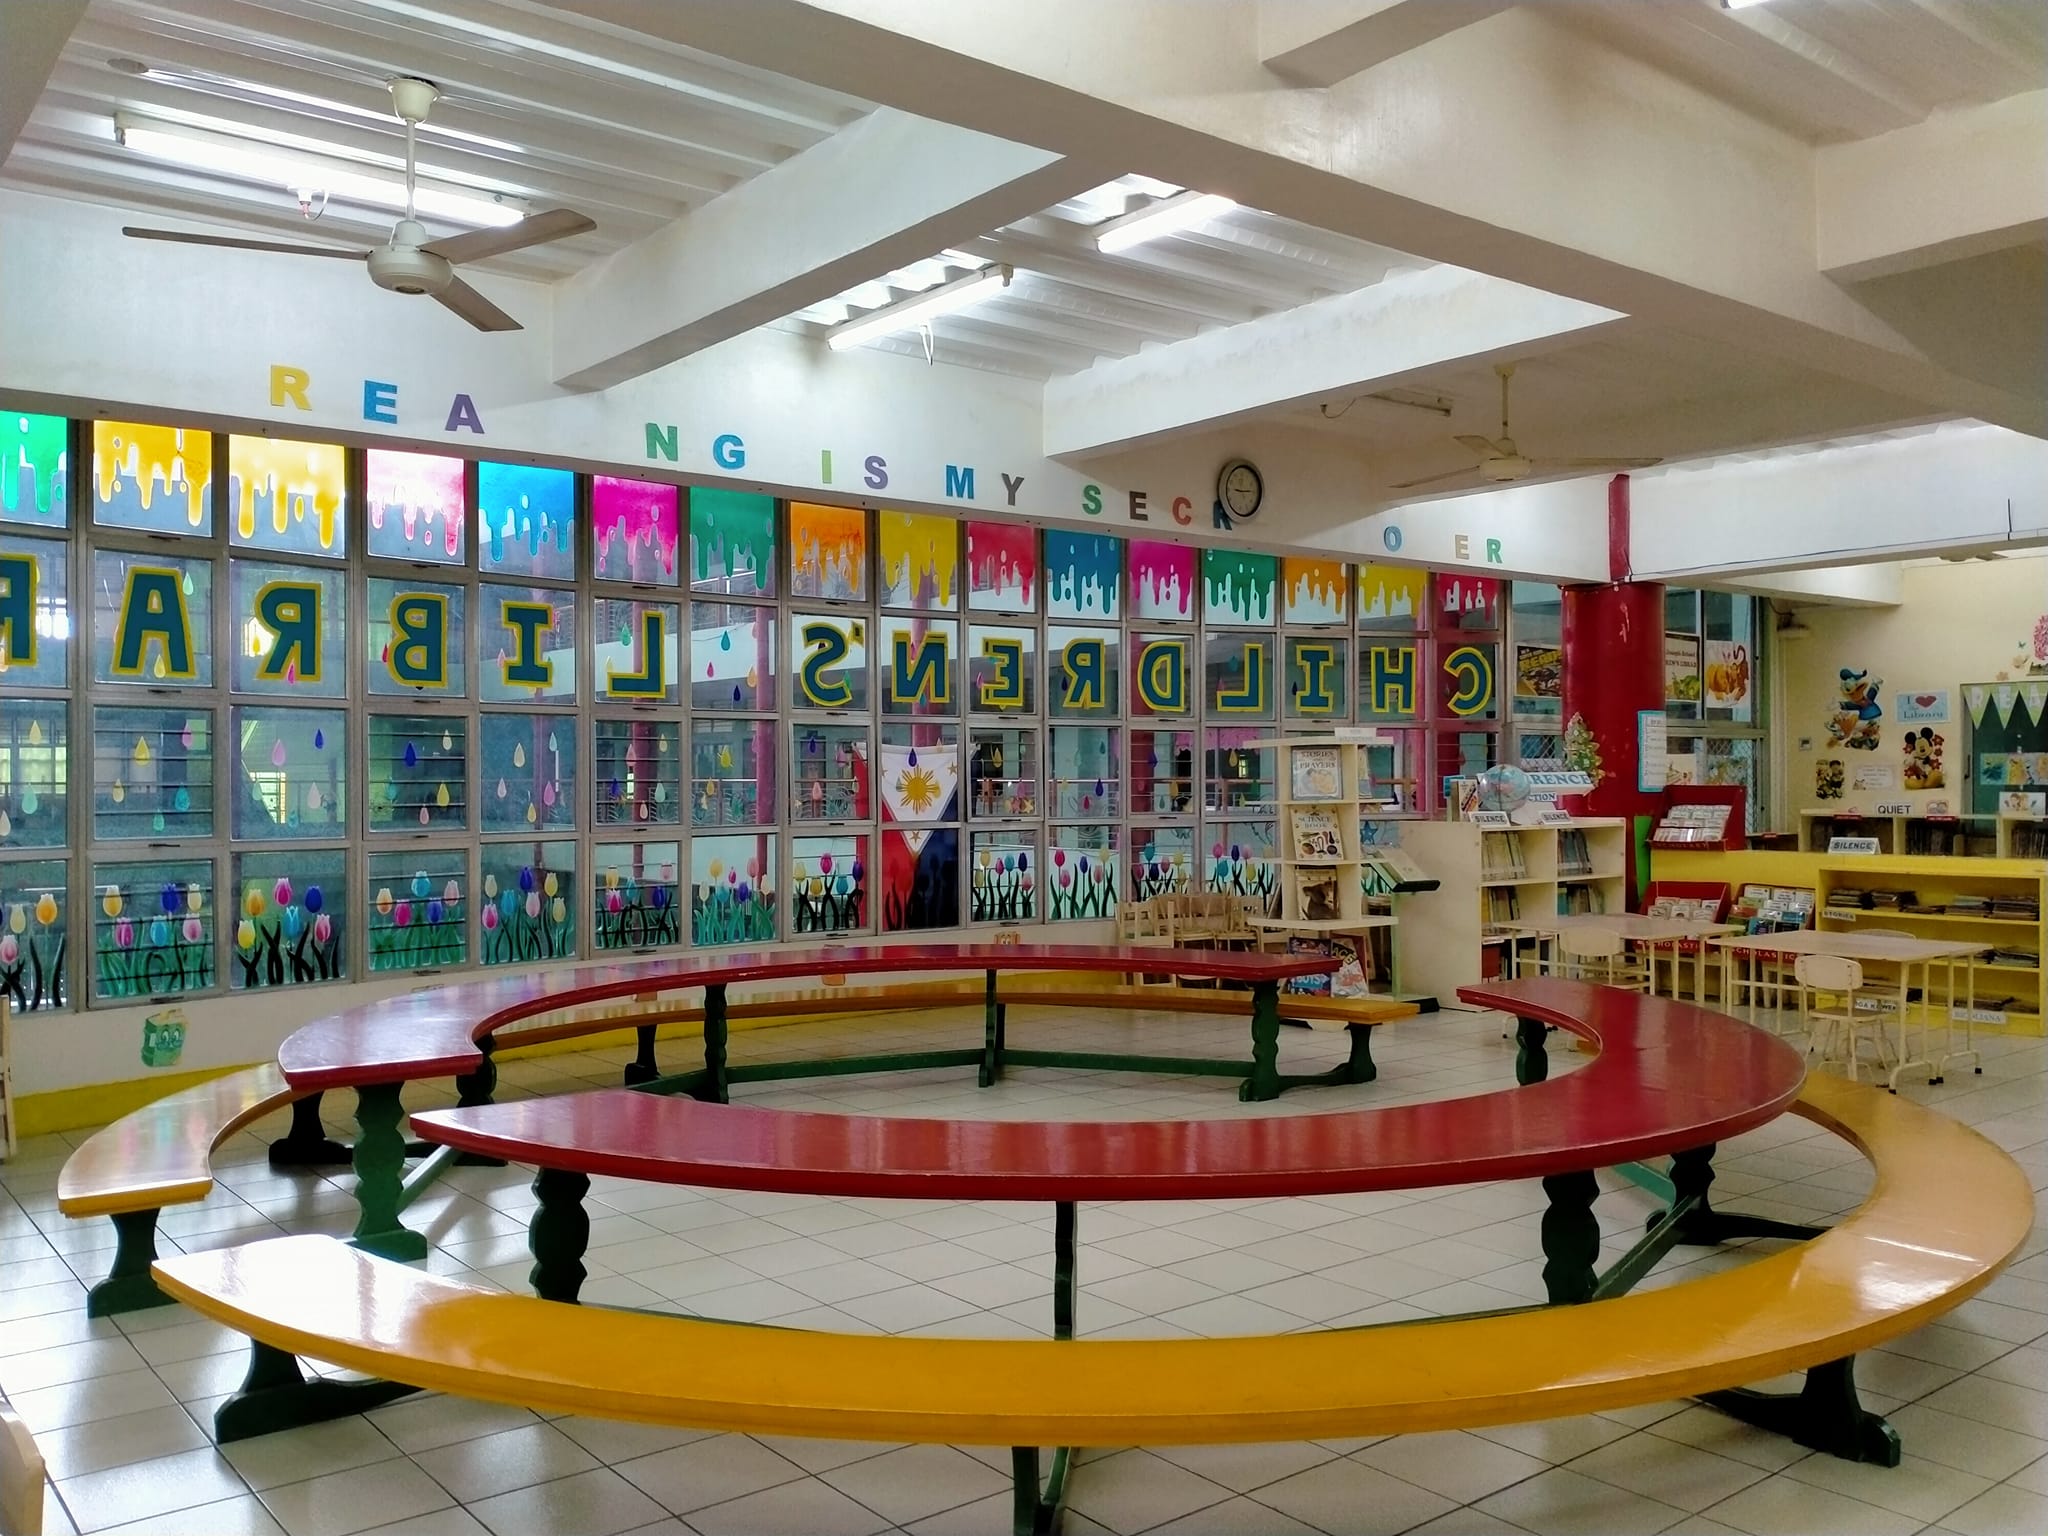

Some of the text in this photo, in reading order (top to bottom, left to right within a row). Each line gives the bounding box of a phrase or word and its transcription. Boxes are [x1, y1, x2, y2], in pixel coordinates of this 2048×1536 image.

[821, 449, 889, 490] IS
[945, 464, 1024, 506] MY
[1529, 773, 1592, 785] RENCE
[1877, 805, 1912, 815] QUIET
[1474, 815, 1505, 823] SILENCE
[1833, 841, 1872, 850] SILENCE
